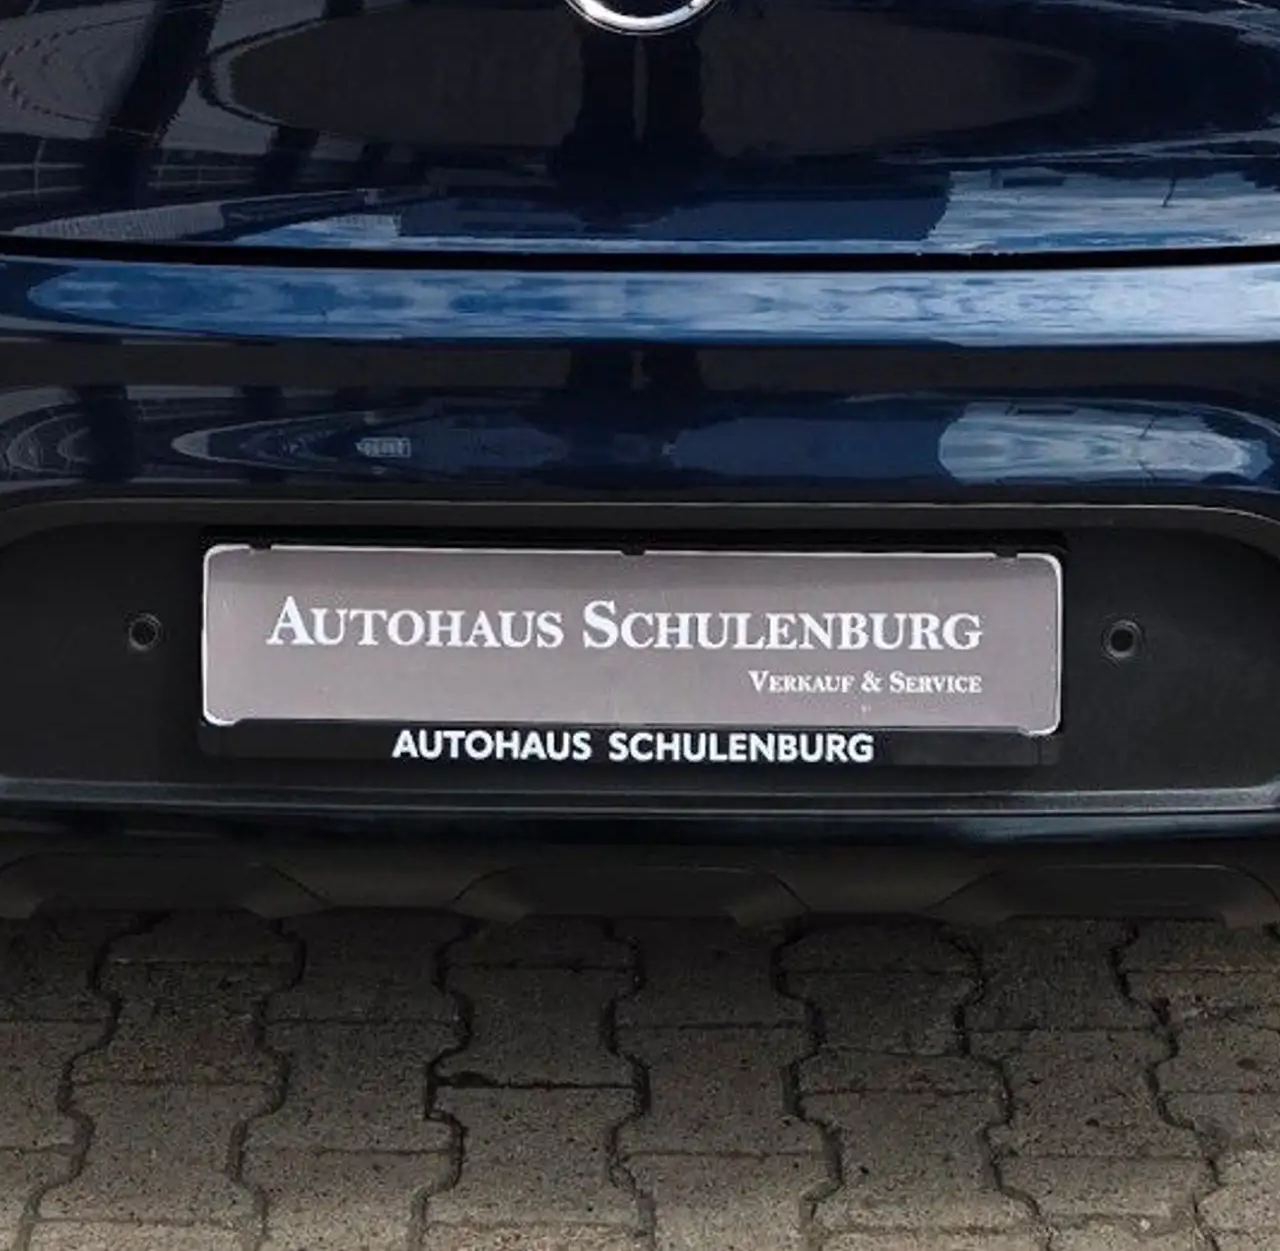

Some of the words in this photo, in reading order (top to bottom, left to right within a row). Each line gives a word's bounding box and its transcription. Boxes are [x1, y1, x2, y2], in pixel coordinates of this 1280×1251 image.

[266, 595, 565, 649] AUTOHAUS
[582, 600, 984, 651] SCHULENBURG
[749, 670, 854, 693] VERKAUF
[860, 670, 882, 693] &
[888, 670, 983, 694] SERVICE
[391, 729, 592, 761] AUTOHAUS
[608, 731, 874, 763] SCHULENBURG
